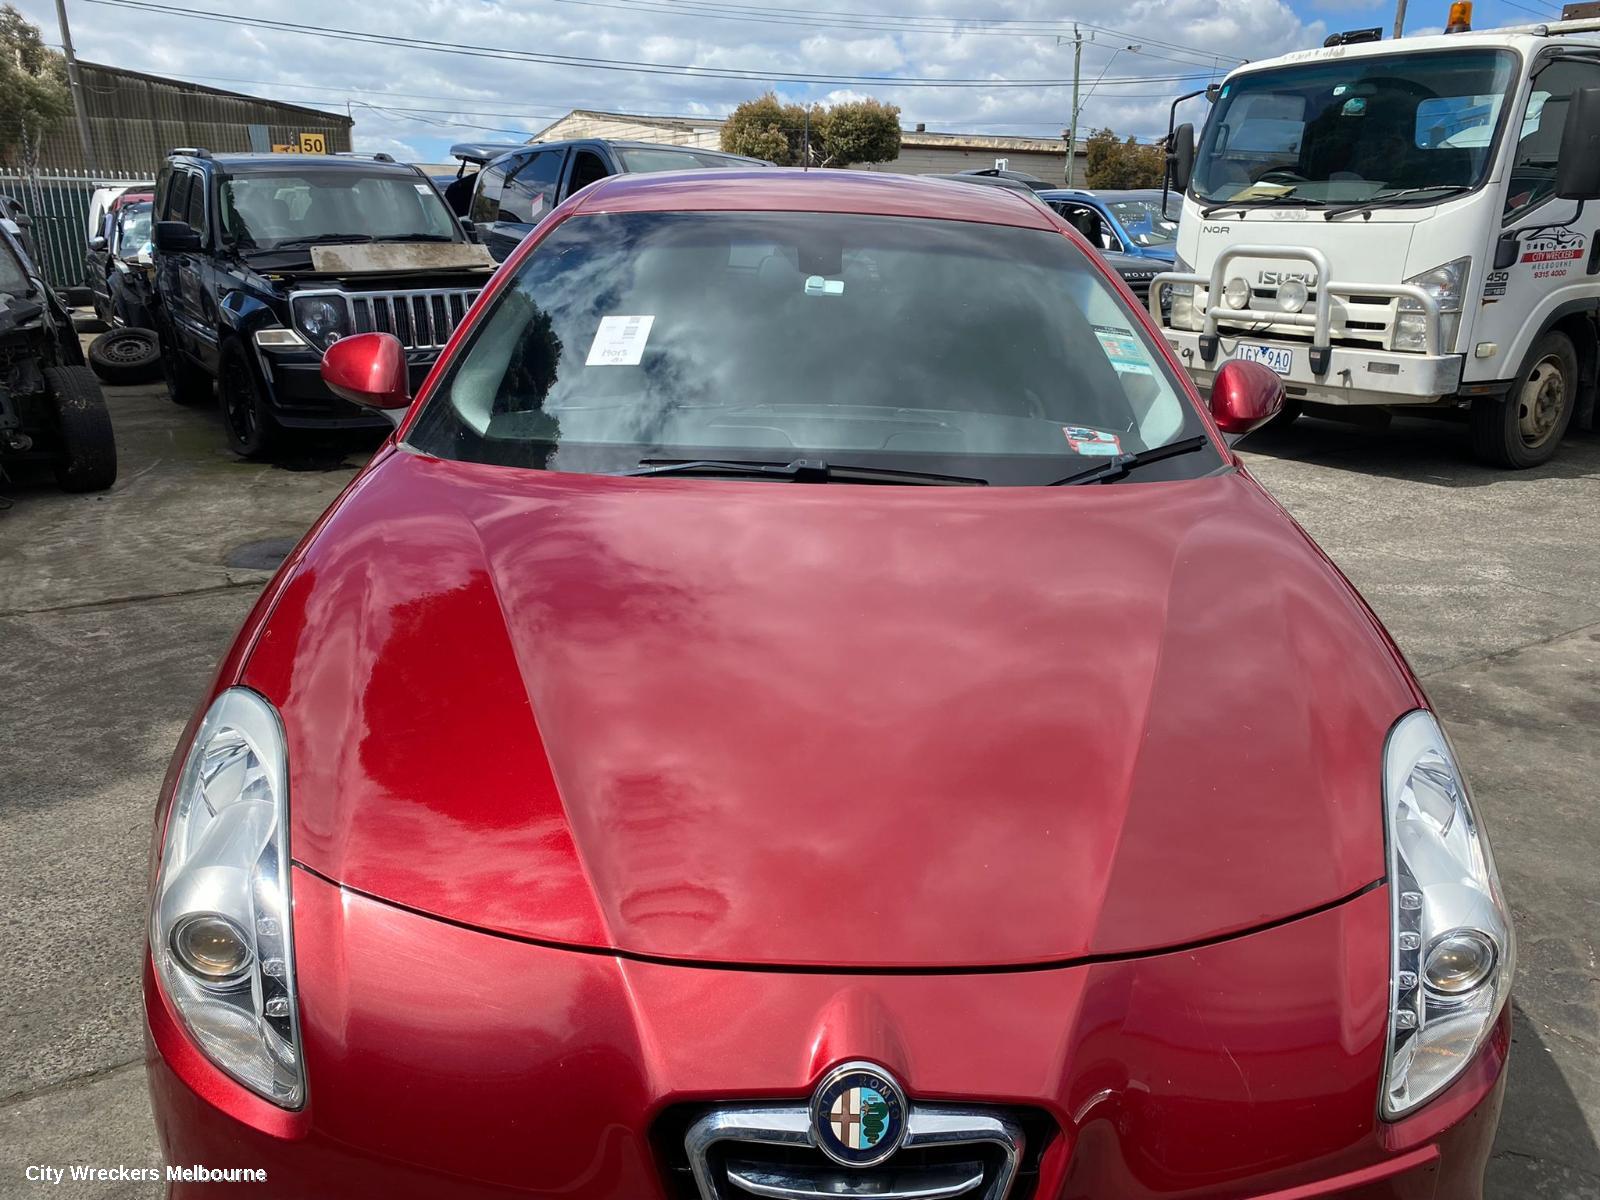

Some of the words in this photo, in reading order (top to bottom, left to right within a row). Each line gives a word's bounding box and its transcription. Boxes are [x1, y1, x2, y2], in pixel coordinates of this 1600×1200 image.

[304, 139, 323, 152] 50
[1532, 253, 1545, 262] CITY
[1546, 250, 1575, 260] WRECKERS
[1531, 261, 1572, 270] MELBOURNE
[1258, 270, 1319, 288] ISUZU
[1486, 272, 1509, 282] 450
[1534, 271, 1549, 279] 9315
[1551, 269, 1567, 277] 4000
[859, 1075, 900, 1120] ROMEO
